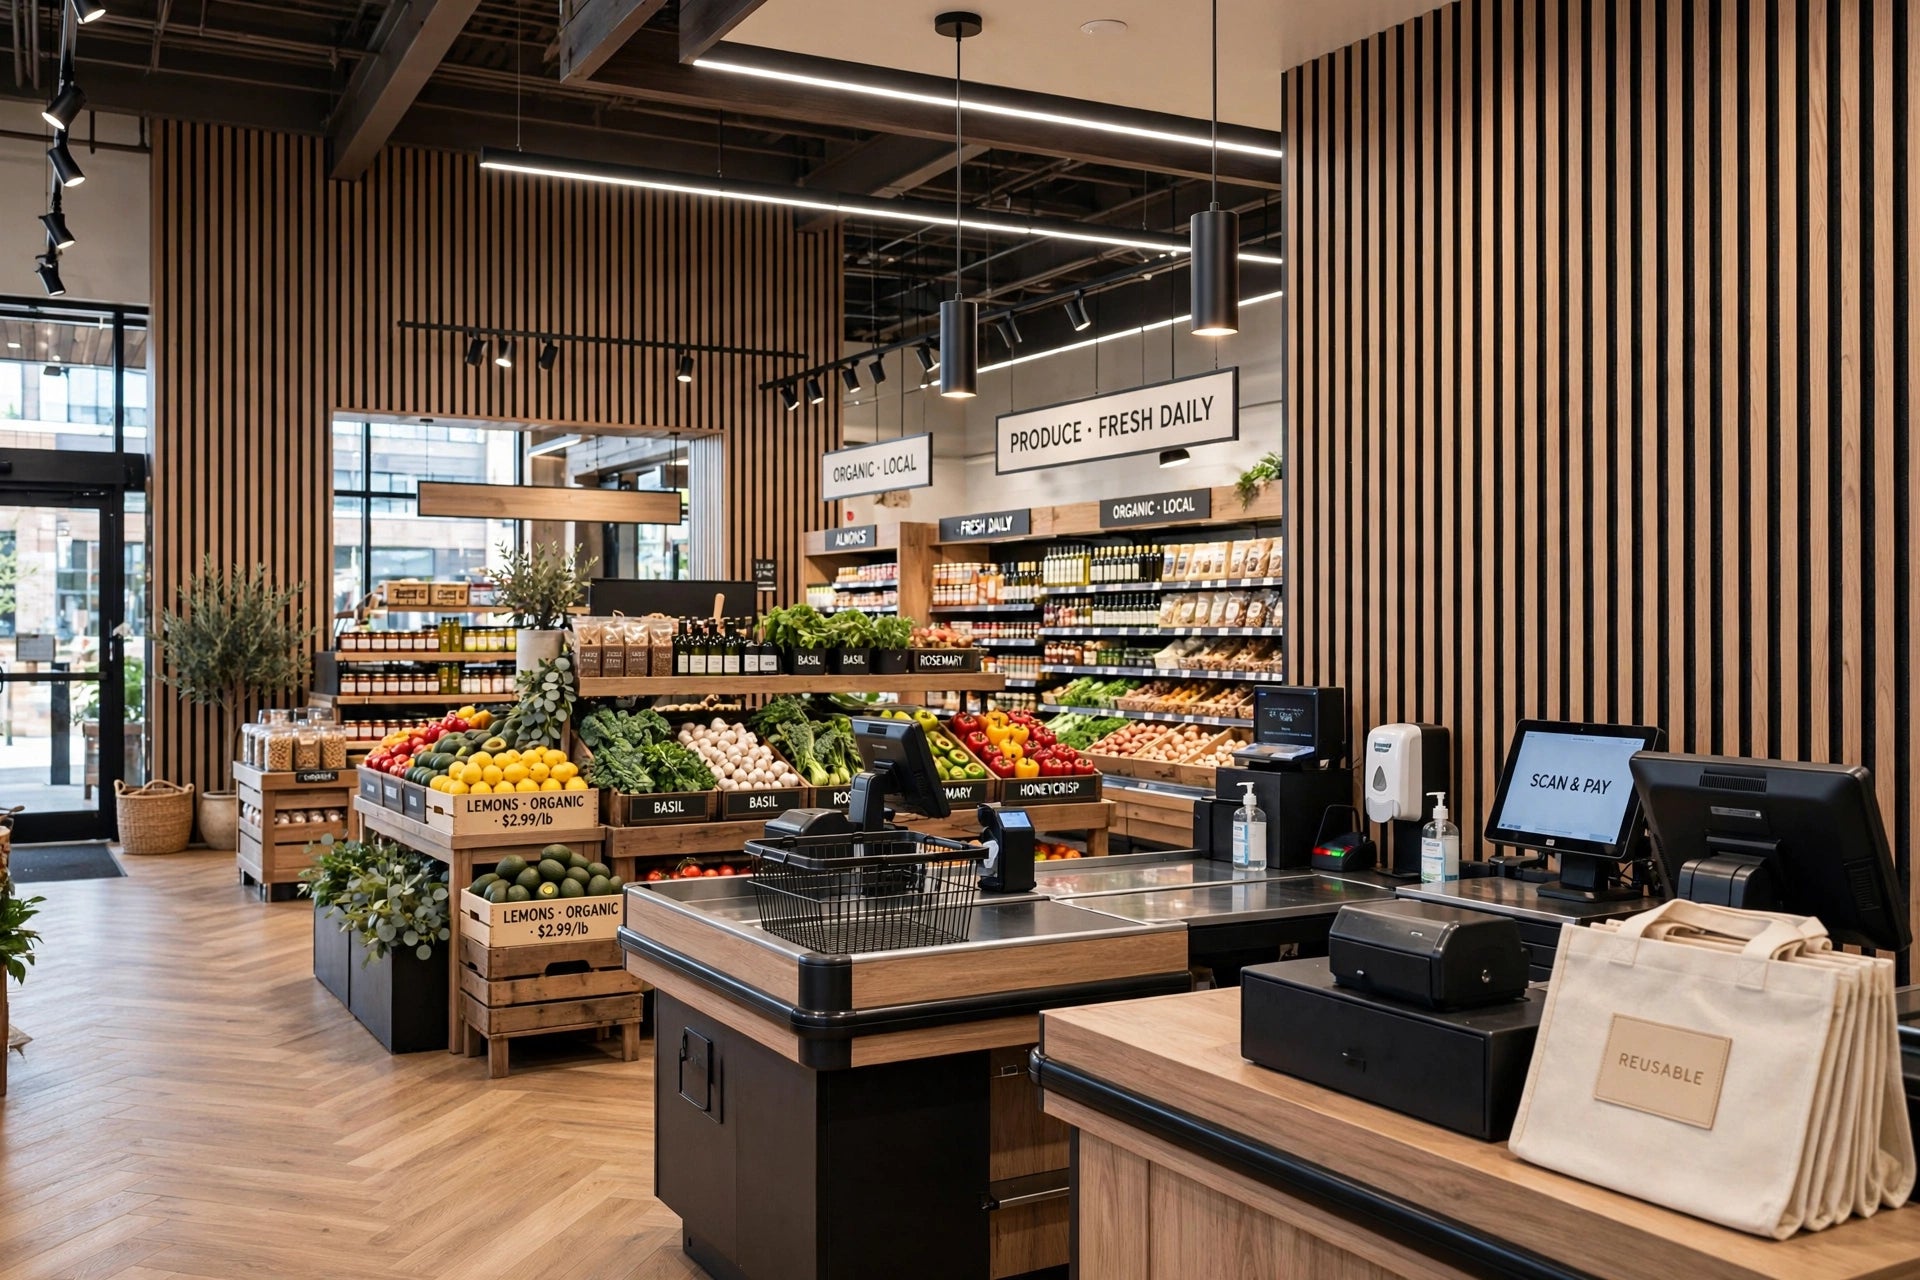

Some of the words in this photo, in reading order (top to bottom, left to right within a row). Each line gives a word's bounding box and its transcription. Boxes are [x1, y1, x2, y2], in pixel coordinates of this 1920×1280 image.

[1010, 420, 1083, 454] PRODUCE
[1099, 407, 1153, 439] FRESH
[1160, 395, 1214, 429] DAILY
[833, 460, 875, 483] ORGANIC
[883, 453, 917, 476] LOCAL
[1112, 501, 1155, 520] ORGANIC
[1163, 496, 1196, 515] LOCAL
[960, 518, 986, 536] FRESH
[987, 514, 1014, 534] DAILY
[797, 654, 821, 666] BASIL
[842, 654, 866, 665] BASIL
[920, 654, 964, 667] ROSEMARY
[941, 786, 974, 800] MARY
[1530, 773, 1569, 791] SCAN
[1569, 776, 1580, 792] &
[1582, 778, 1613, 795] PAY
[466, 797, 519, 813] LEMONS
[530, 794, 584, 810] ORGANIC
[654, 800, 685, 814] BASIL
[749, 795, 779, 809] BASIL
[502, 813, 553, 828] $2.99/lb
[503, 906, 555, 924] LEMONS
[565, 901, 619, 919] ORGANIC
[537, 922, 589, 939] $2.99/lb
[1618, 1052, 1705, 1086] REUSABLE
